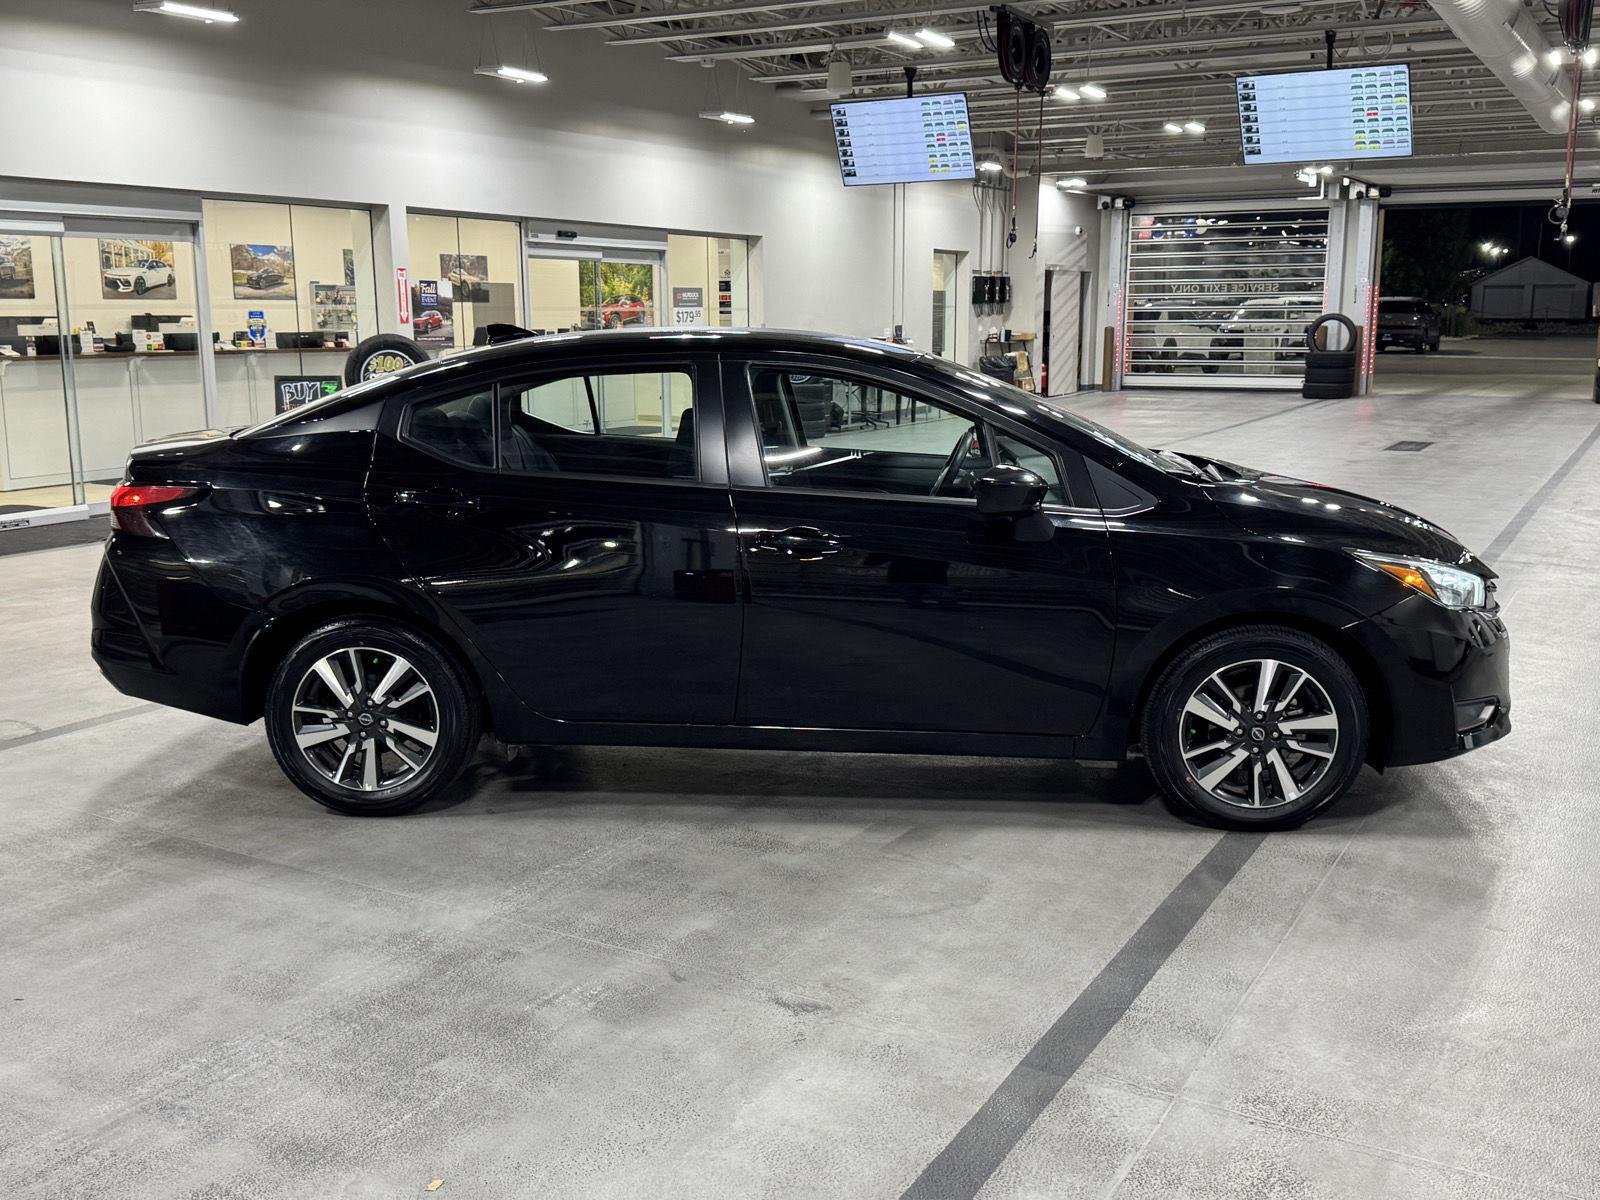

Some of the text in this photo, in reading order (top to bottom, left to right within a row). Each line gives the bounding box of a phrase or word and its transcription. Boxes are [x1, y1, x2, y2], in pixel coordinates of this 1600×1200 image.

[420, 283, 436, 294] Fall
[369, 356, 403, 373] $100
[281, 382, 319, 403] BUY
